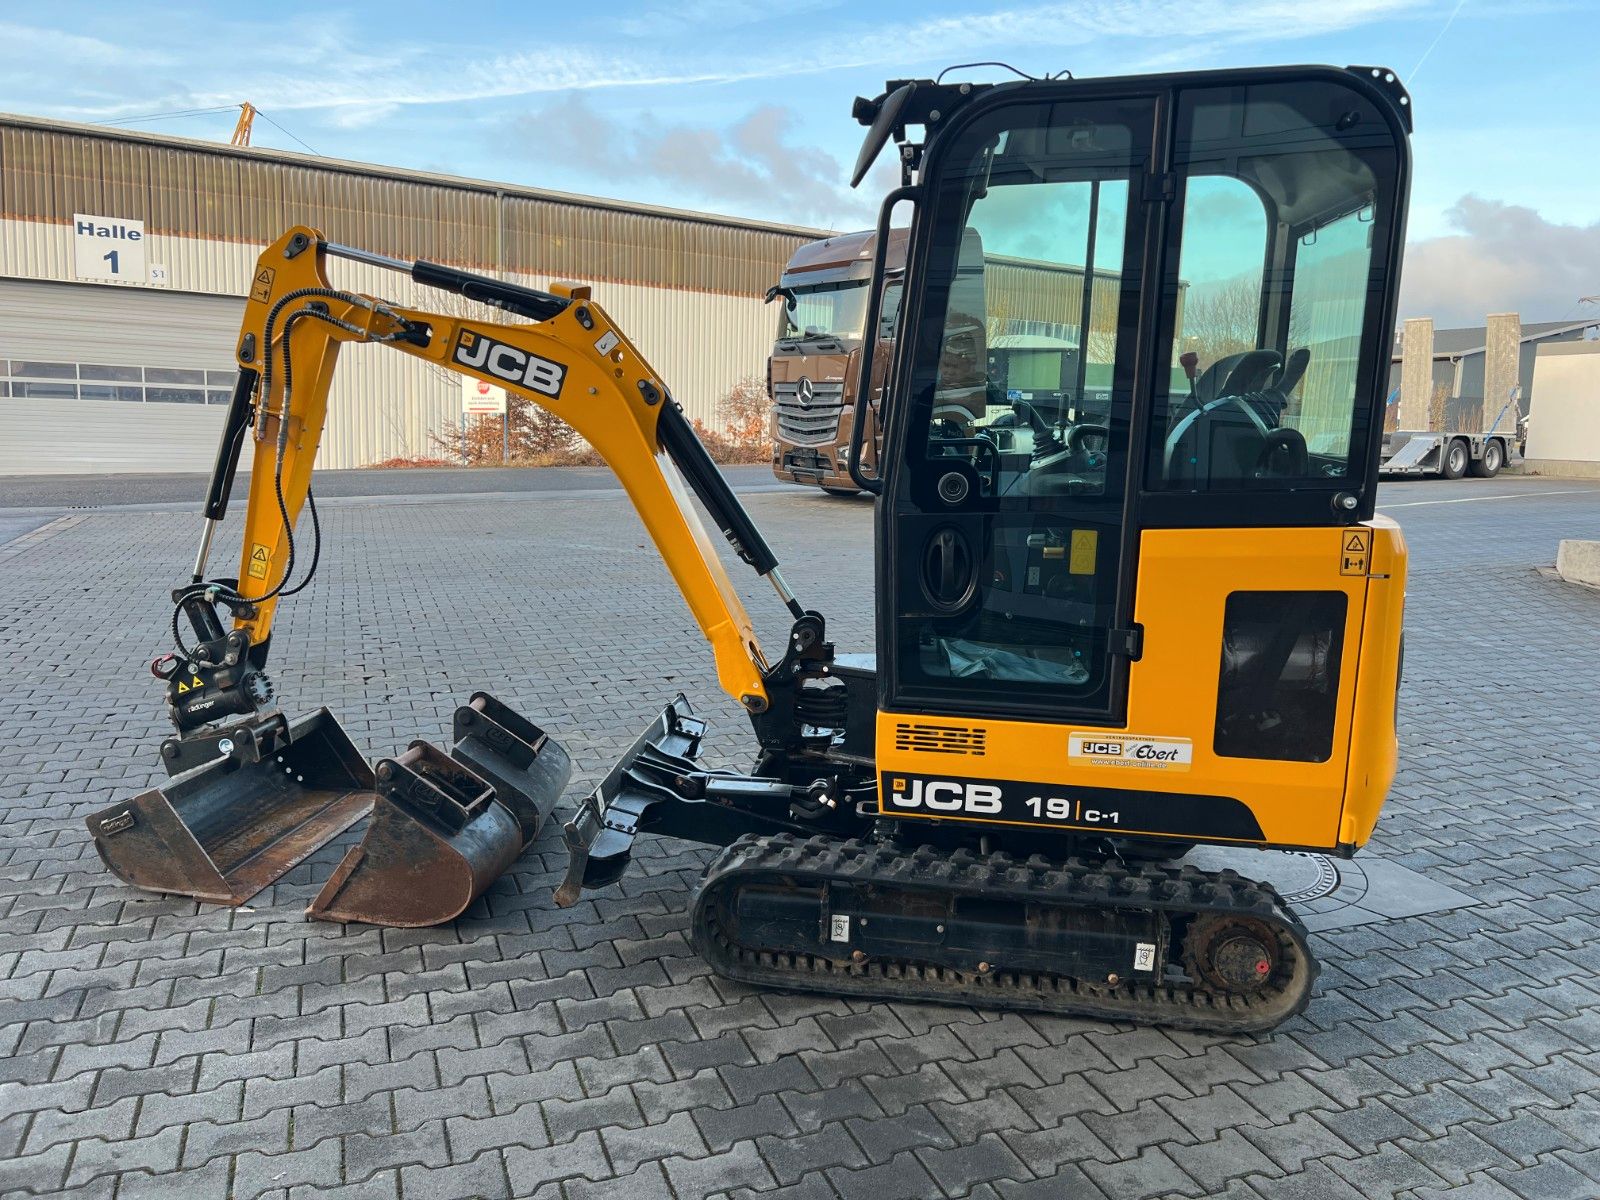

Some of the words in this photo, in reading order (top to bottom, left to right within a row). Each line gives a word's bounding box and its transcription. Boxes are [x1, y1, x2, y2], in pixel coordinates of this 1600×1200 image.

[77, 221, 142, 241] Halle
[104, 250, 119, 274] 1
[457, 337, 563, 395] JCB
[1083, 743, 1121, 755] JCB
[1136, 745, 1179, 761] Ebert
[893, 779, 1002, 814] JCB
[1025, 797, 1070, 819] 19
